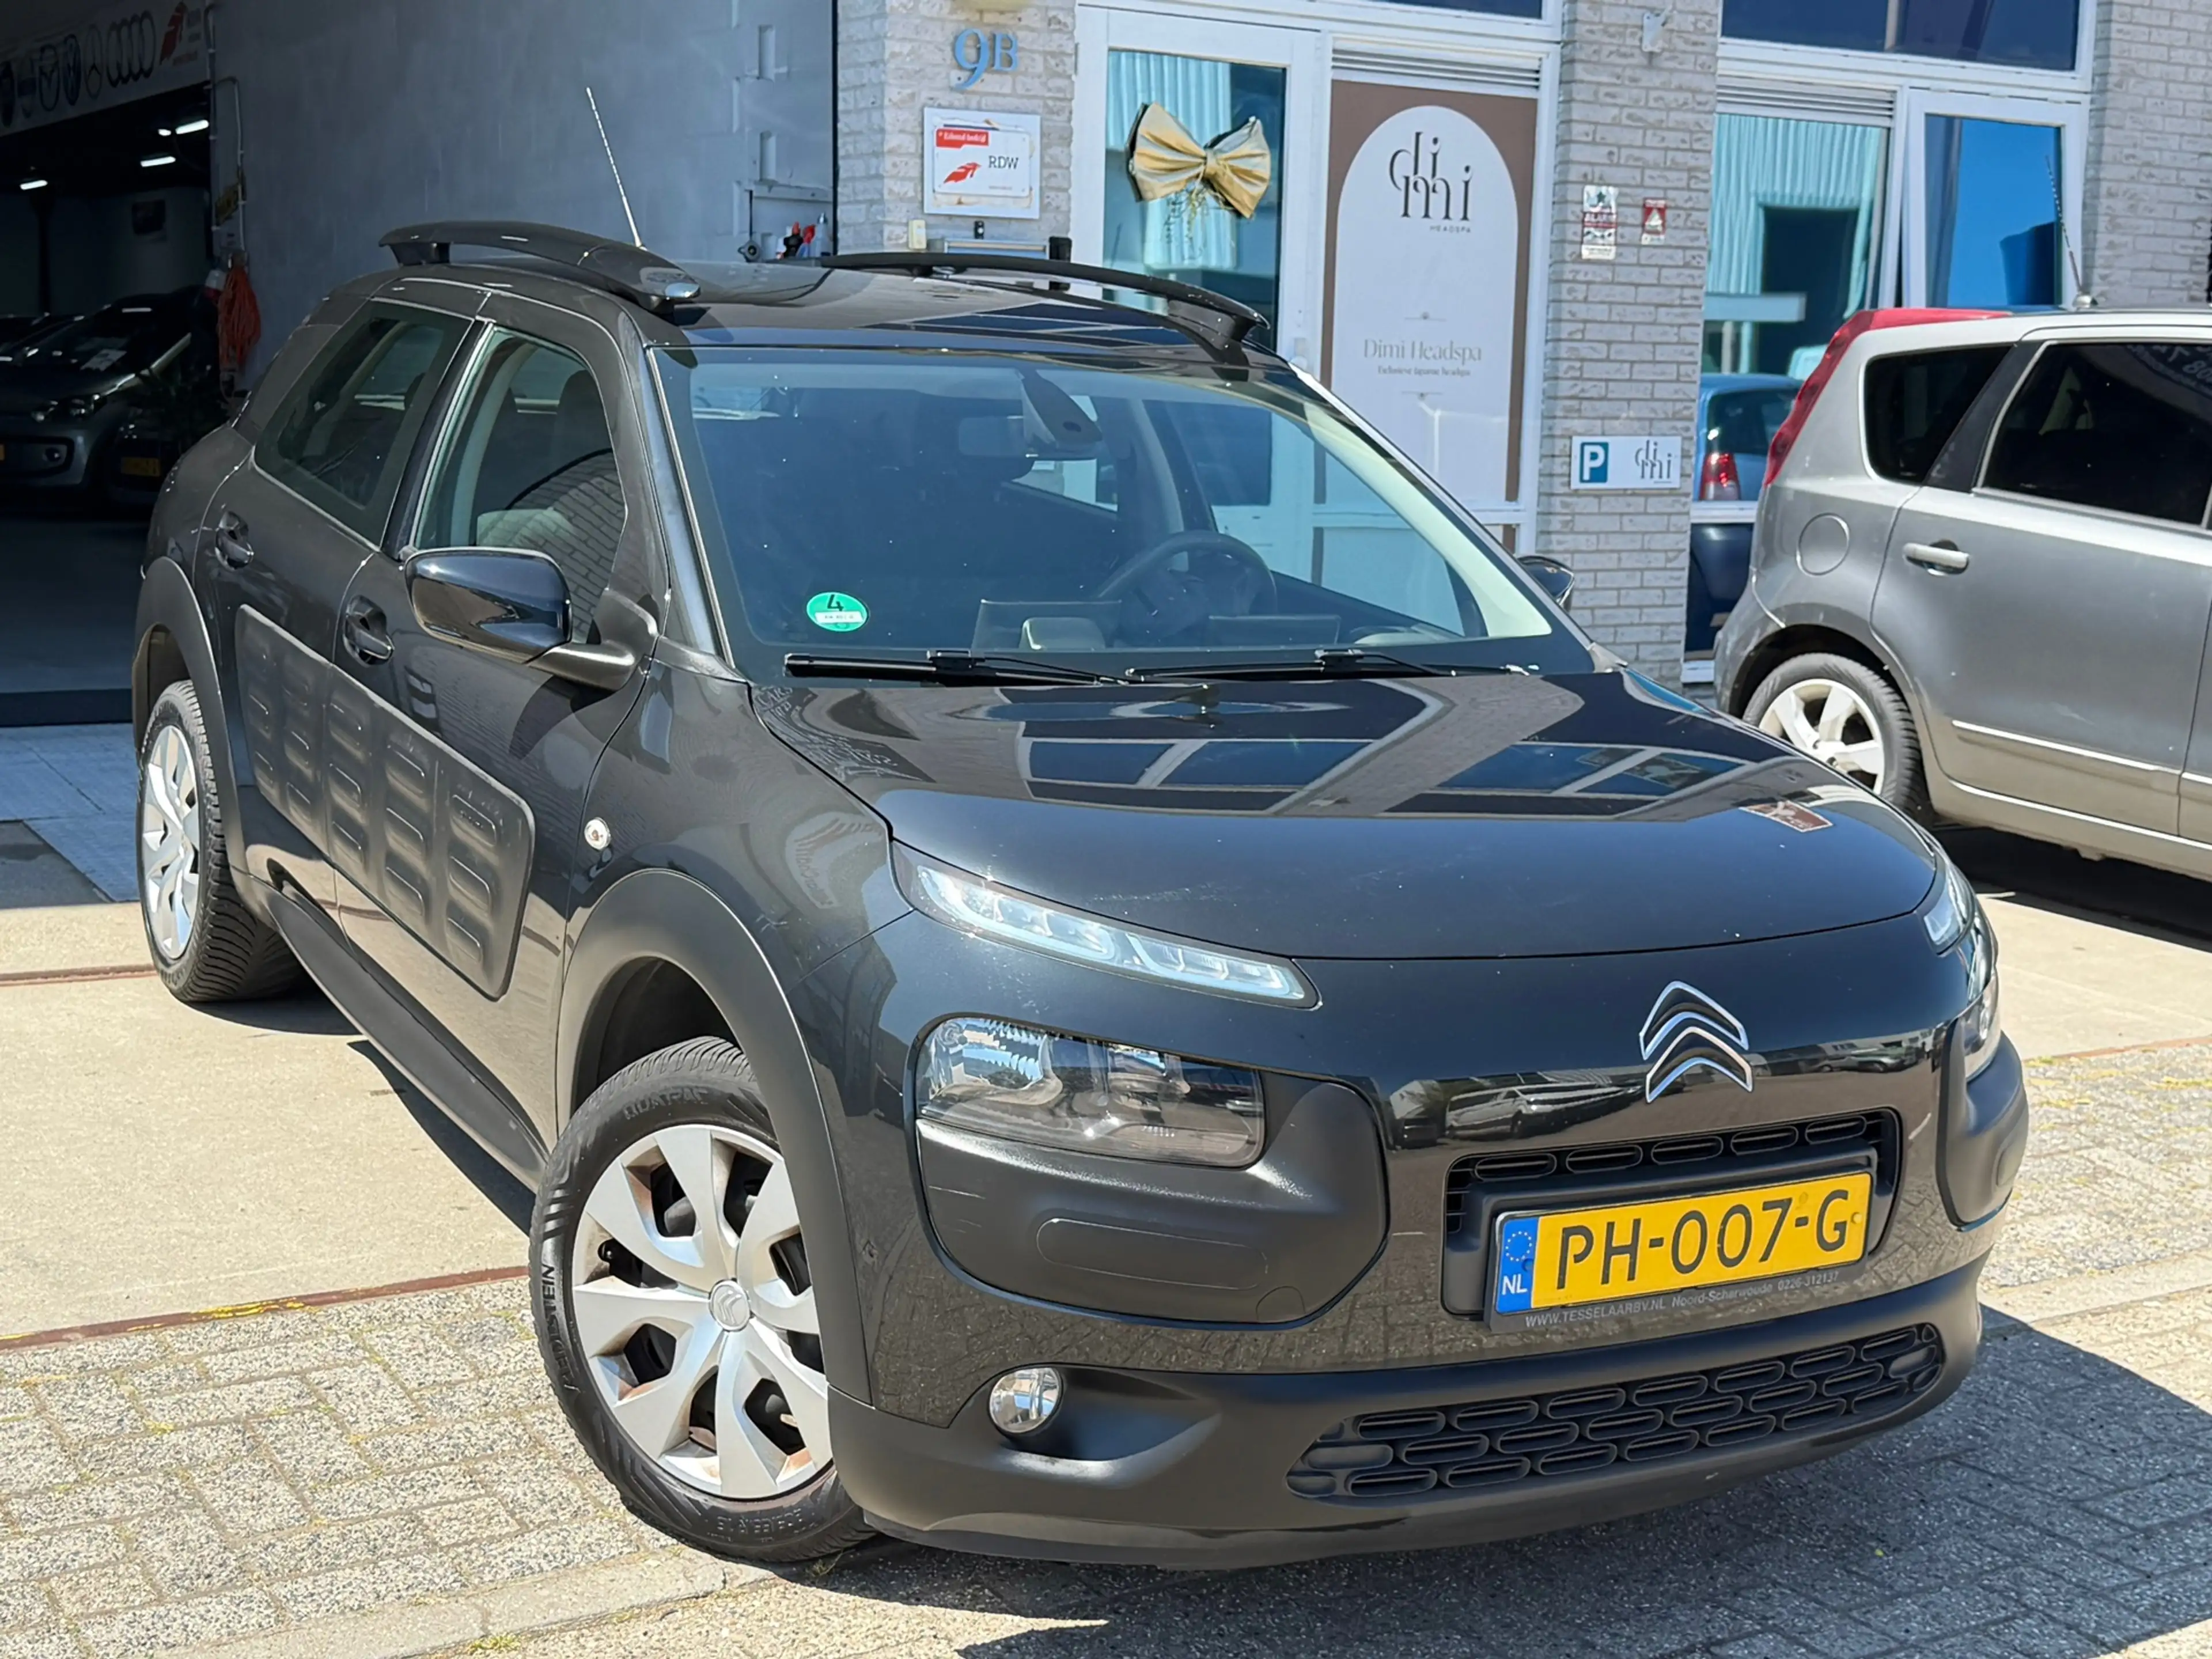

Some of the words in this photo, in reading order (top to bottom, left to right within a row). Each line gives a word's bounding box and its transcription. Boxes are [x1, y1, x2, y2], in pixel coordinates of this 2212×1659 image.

[953, 28, 1018, 89] 9B
[988, 155, 1019, 169] RDW
[1429, 225, 1471, 233] HEADSPA
[1363, 339, 1406, 359] Dimi
[1411, 339, 1482, 366] Headspa
[1582, 445, 1605, 481] P
[827, 594, 844, 612] 4
[1556, 1189, 1849, 1290] PH-007-G
[1502, 1274, 1528, 1296] NL
[1526, 1298, 1666, 1327] WWW.TESSELAARBV.NL
